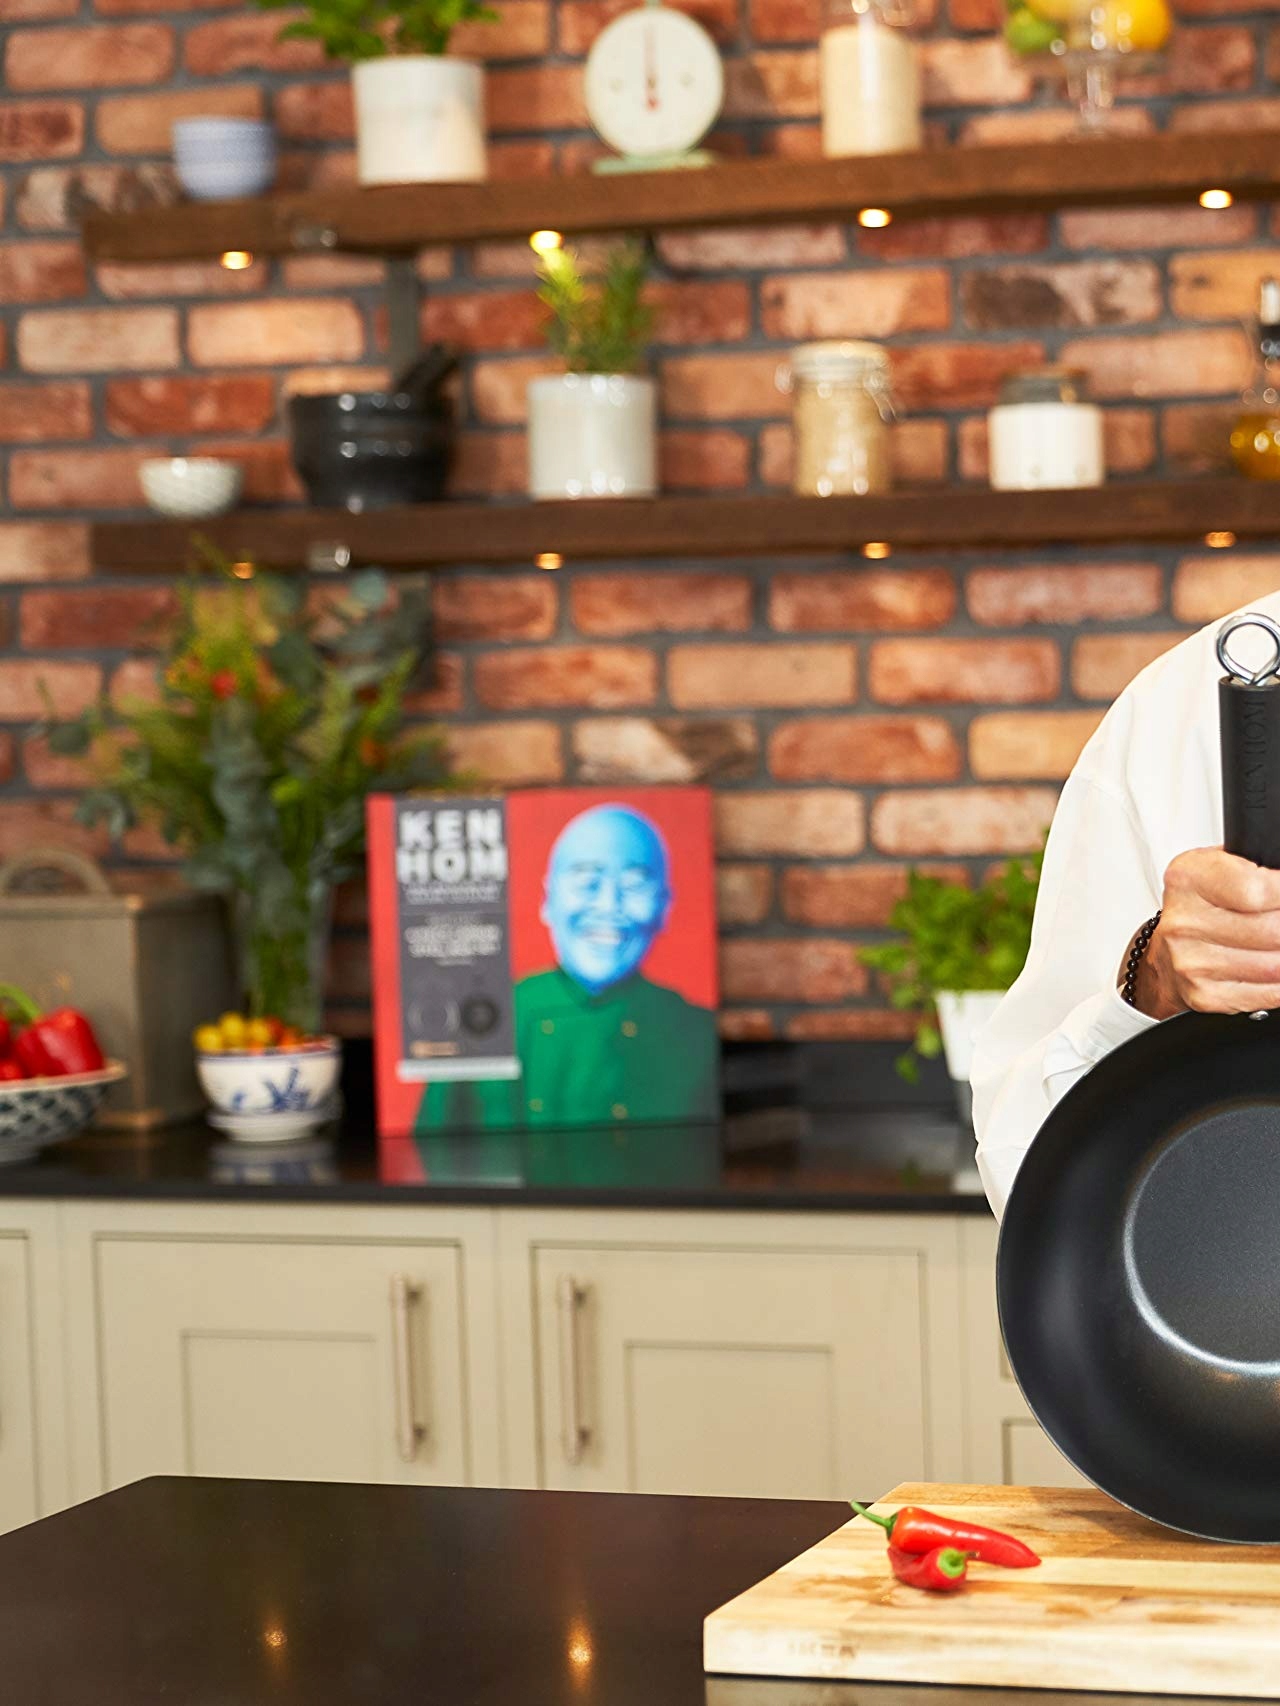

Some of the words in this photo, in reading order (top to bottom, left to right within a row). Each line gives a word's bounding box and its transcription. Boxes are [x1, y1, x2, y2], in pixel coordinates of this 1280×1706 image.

[1243, 701, 1268, 755] HOM
[400, 808, 503, 850] KEN
[397, 848, 508, 884] HOM
